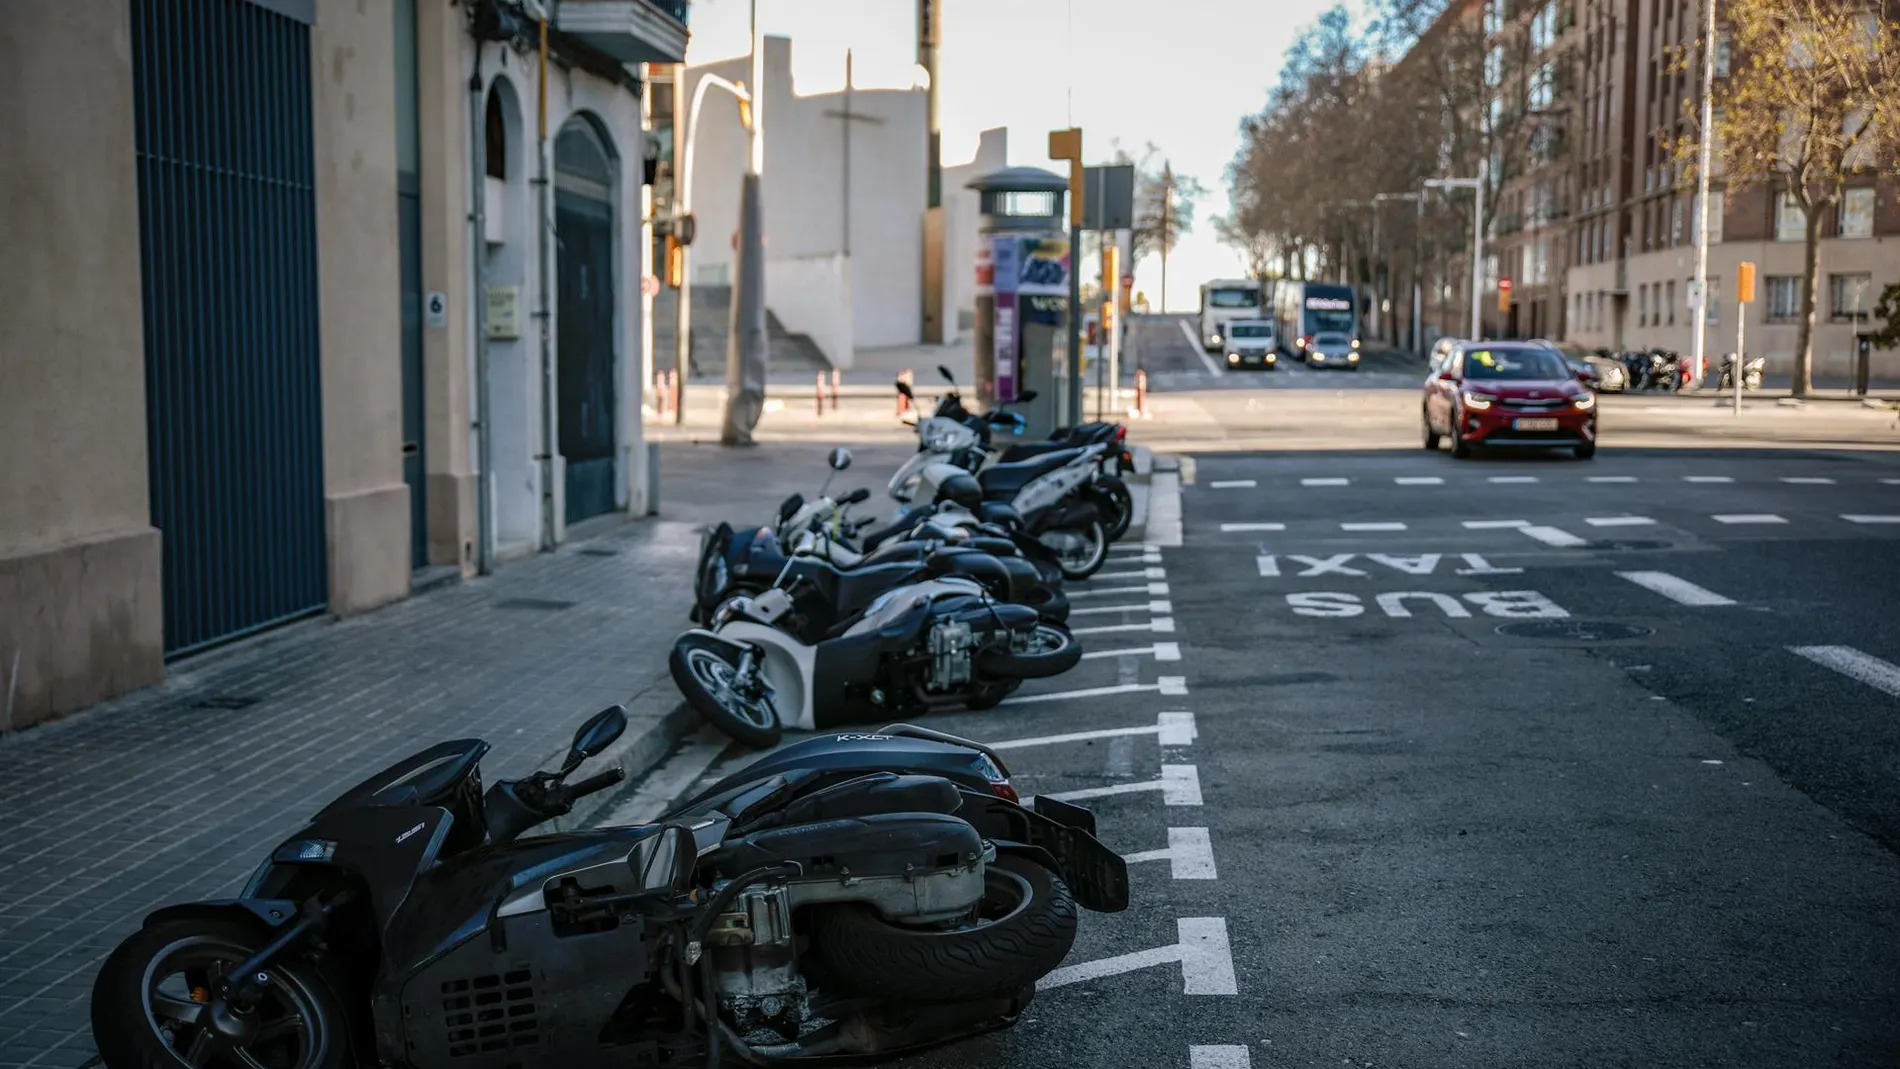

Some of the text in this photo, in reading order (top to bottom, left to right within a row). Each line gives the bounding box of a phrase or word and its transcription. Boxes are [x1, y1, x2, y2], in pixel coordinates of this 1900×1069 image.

[430, 295, 442, 314] 6
[1256, 553, 1523, 576] TAXI
[1285, 590, 1570, 618] BUS
